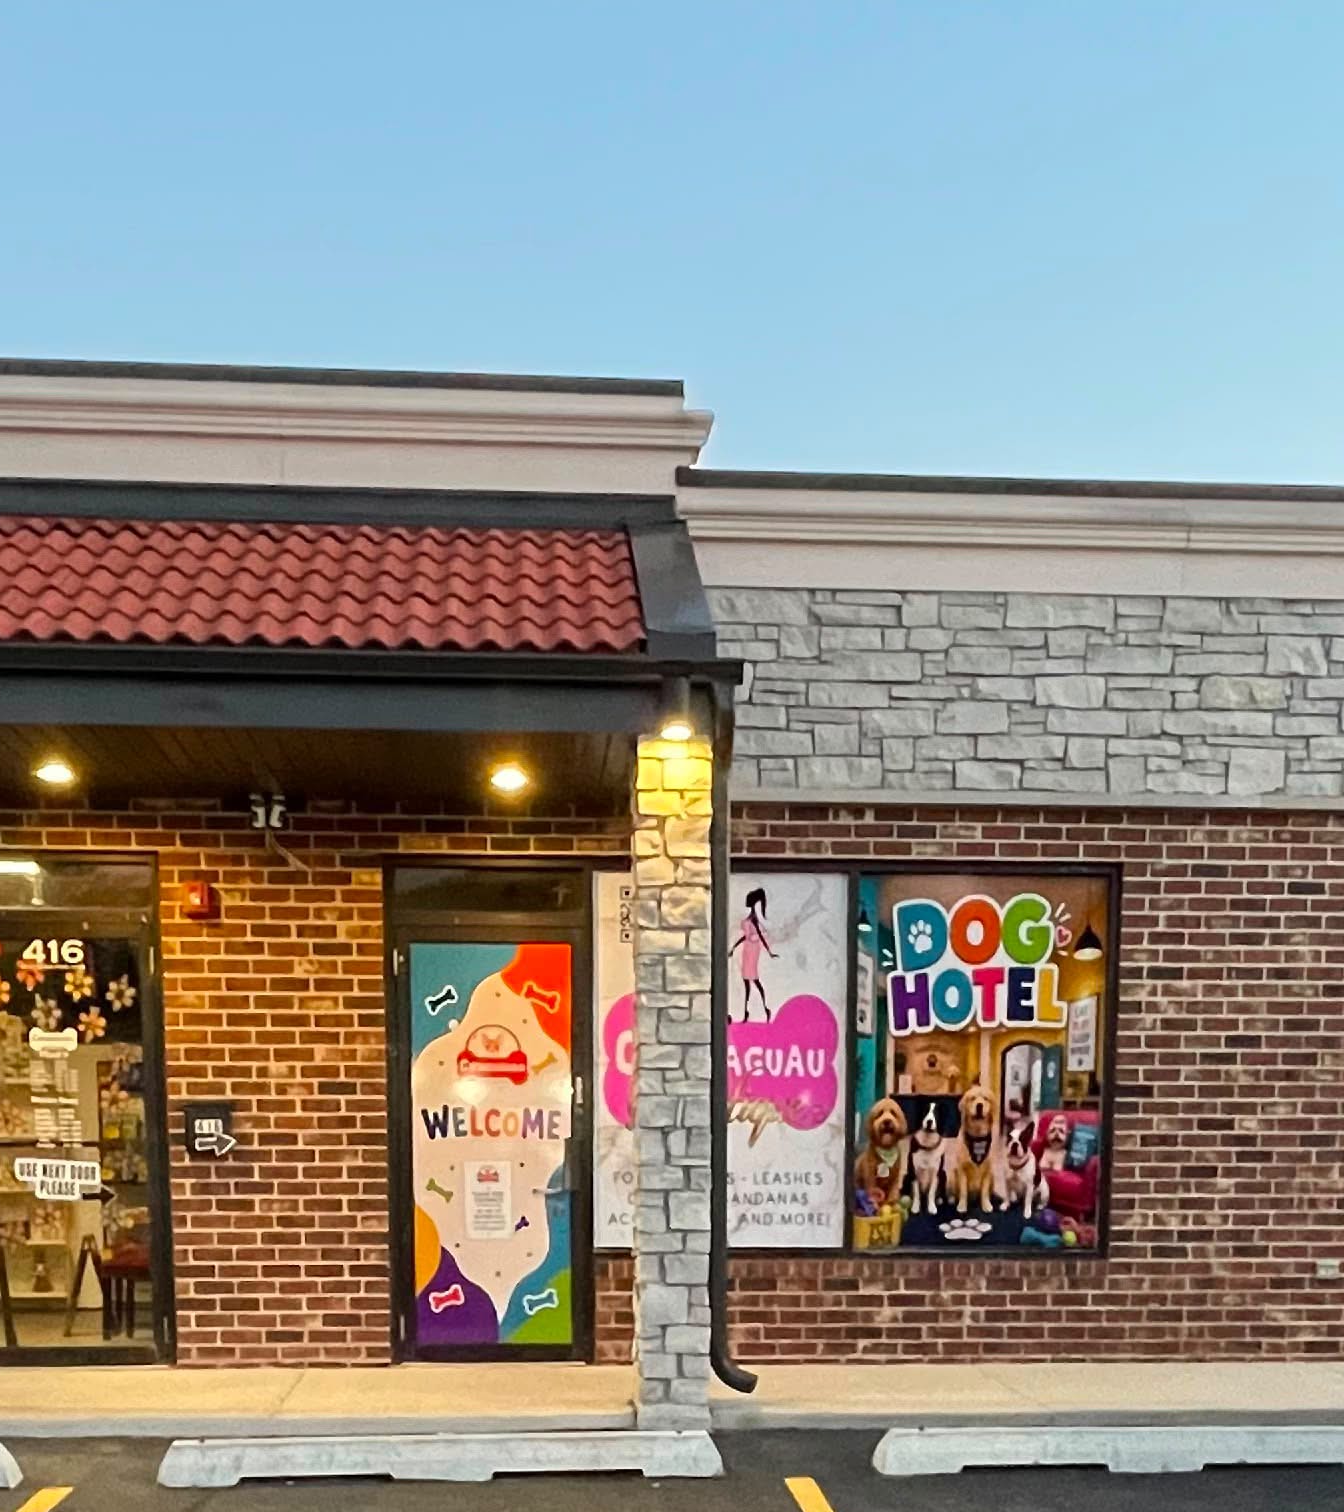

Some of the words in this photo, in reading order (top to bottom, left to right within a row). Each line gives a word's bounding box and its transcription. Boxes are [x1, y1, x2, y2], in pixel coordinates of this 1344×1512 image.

[894, 895, 1054, 972] DOG
[22, 938, 86, 964] 416
[888, 965, 1066, 1034] HOTEL
[421, 1104, 562, 1140] WELCOME
[18, 1162, 38, 1178] USE
[42, 1163, 66, 1179] NEXT
[70, 1164, 97, 1181] DOOR
[753, 1171, 824, 1186] LEASHES
[39, 1179, 76, 1196] PLEASE
[740, 1213, 774, 1226] AND
